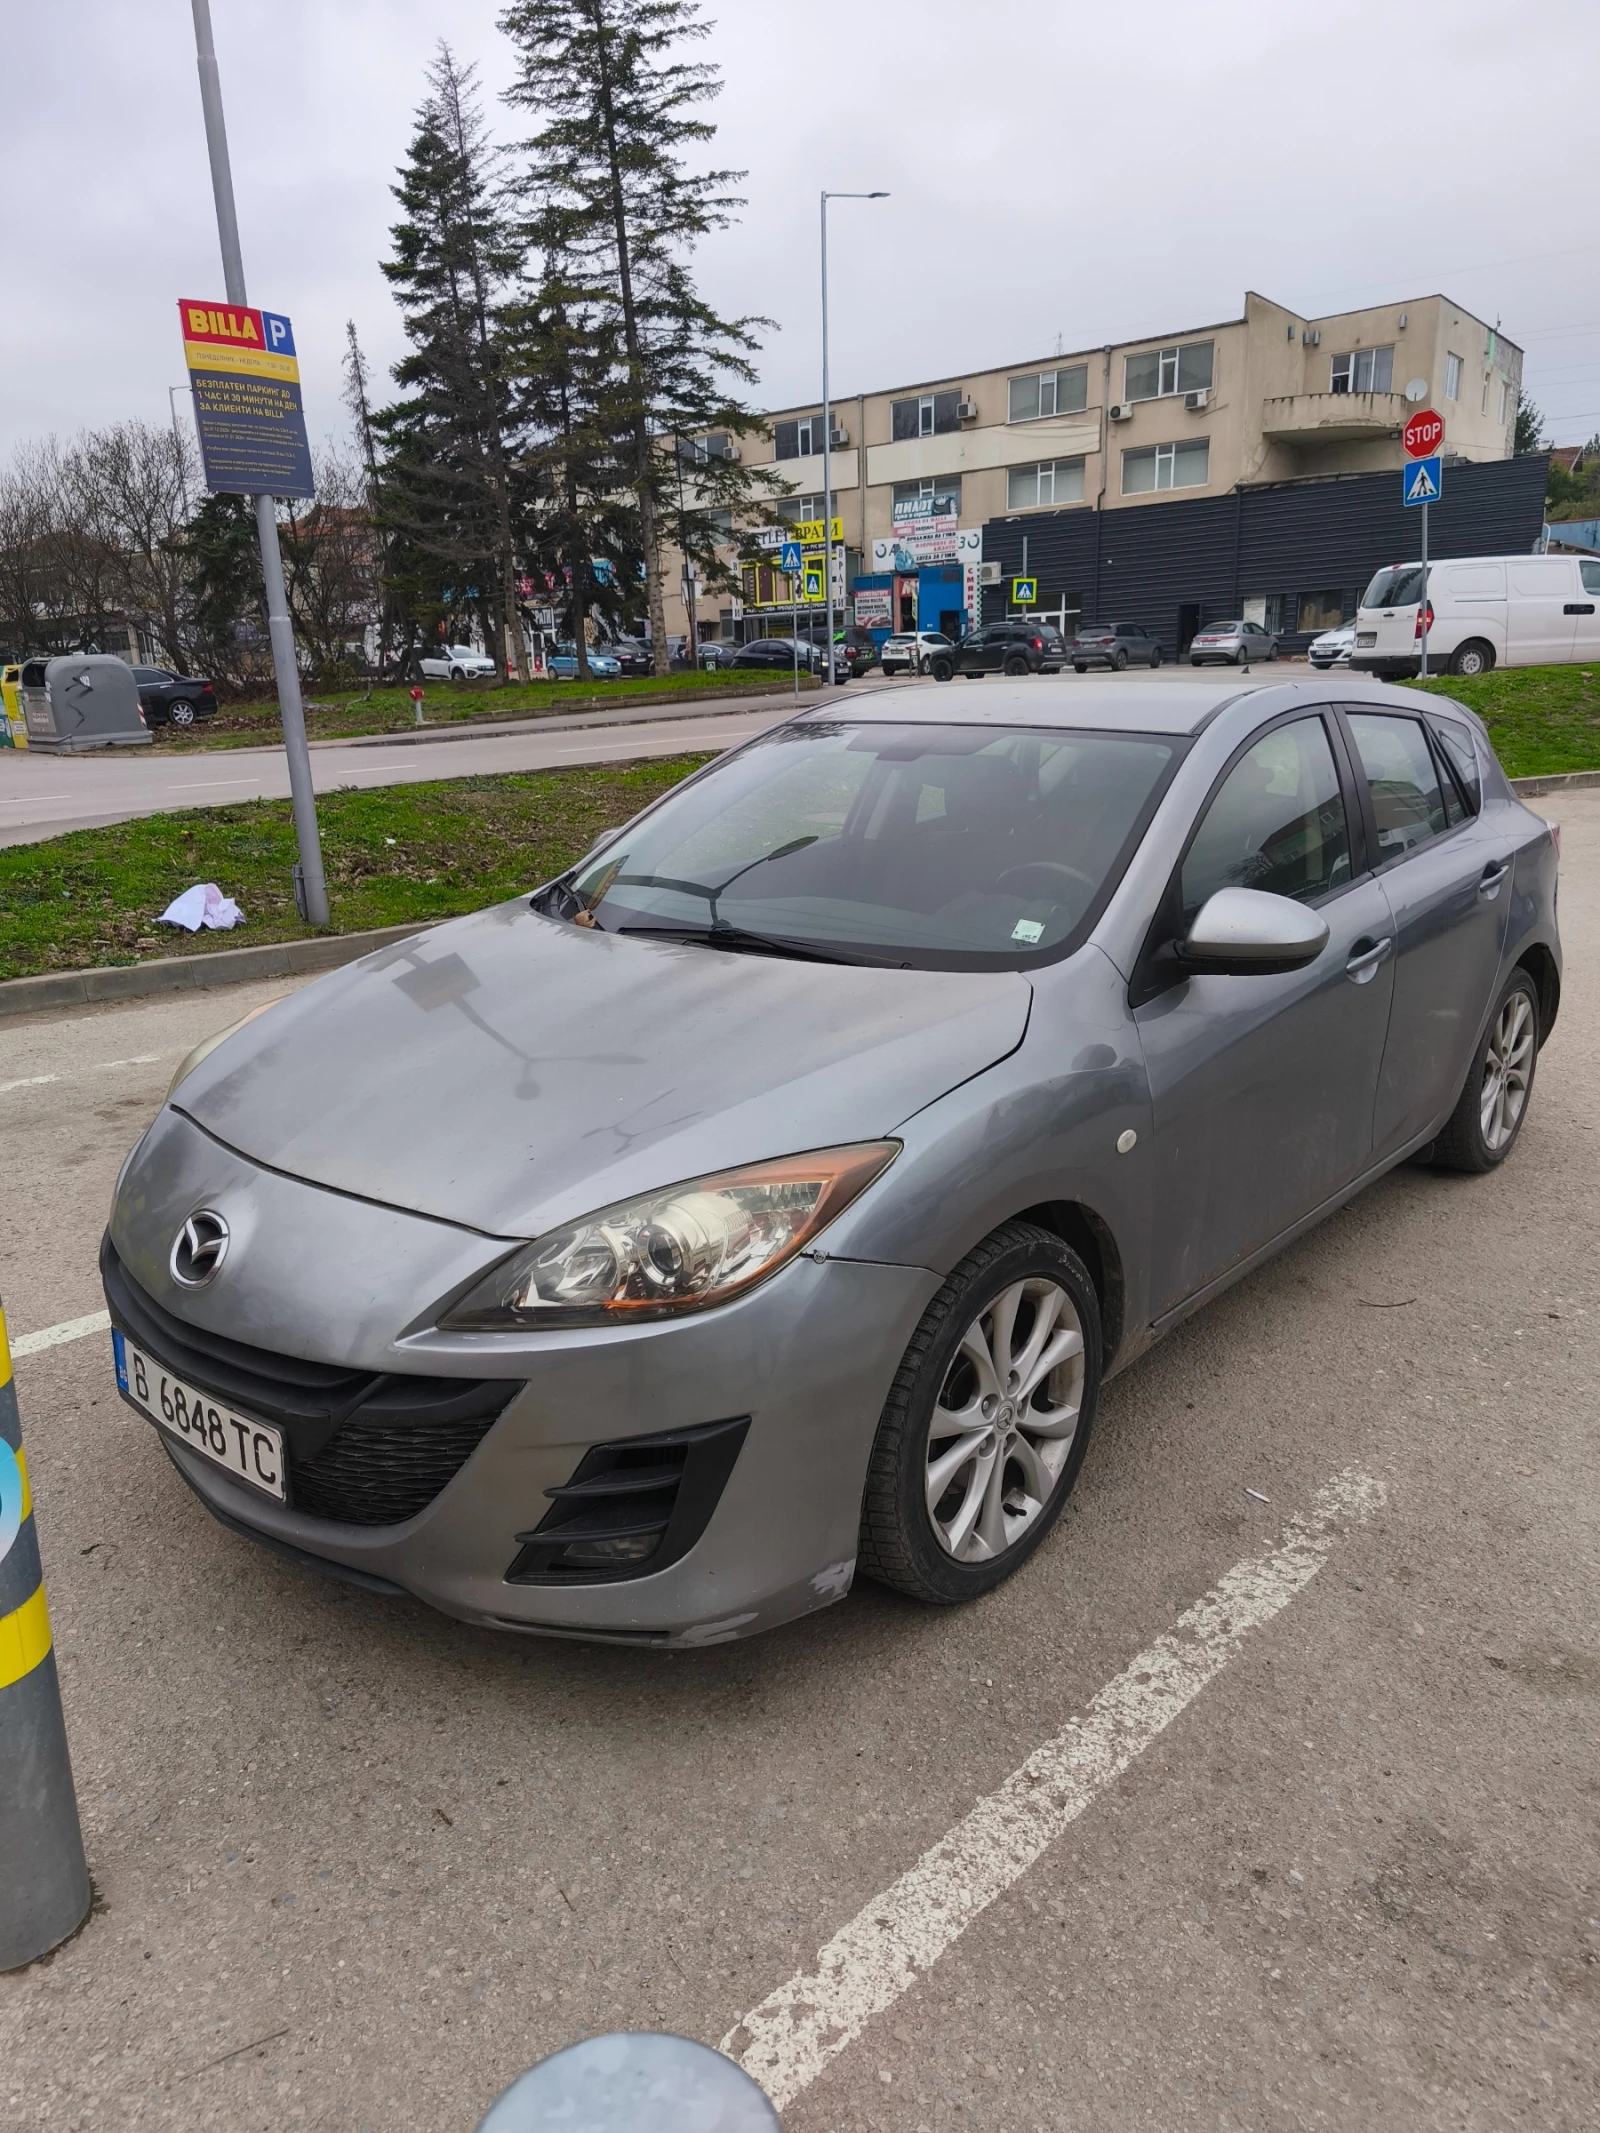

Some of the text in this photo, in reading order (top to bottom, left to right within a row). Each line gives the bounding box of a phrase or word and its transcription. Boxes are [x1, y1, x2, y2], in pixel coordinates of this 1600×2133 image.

[188, 308, 259, 341] BILLA
[270, 318, 286, 346] P
[196, 379, 291, 399] БЕЗПЛАТЕН ПАРКИНГ ДО
[204, 391, 222, 400] ЧАС
[223, 393, 230, 401] И
[231, 394, 241, 402] 30
[242, 395, 273, 406] МИНУТИ
[274, 399, 284, 408] НА
[284, 401, 298, 411] ДЕН
[200, 402, 284, 419] ЗА КЛИЕНТИ НА BILLA
[1406, 422, 1441, 446] STOP
[795, 522, 839, 540] ВРАТИ
[837, 548, 845, 608] ВРАТИ
[133, 1352, 276, 1485] B 6848 TC
